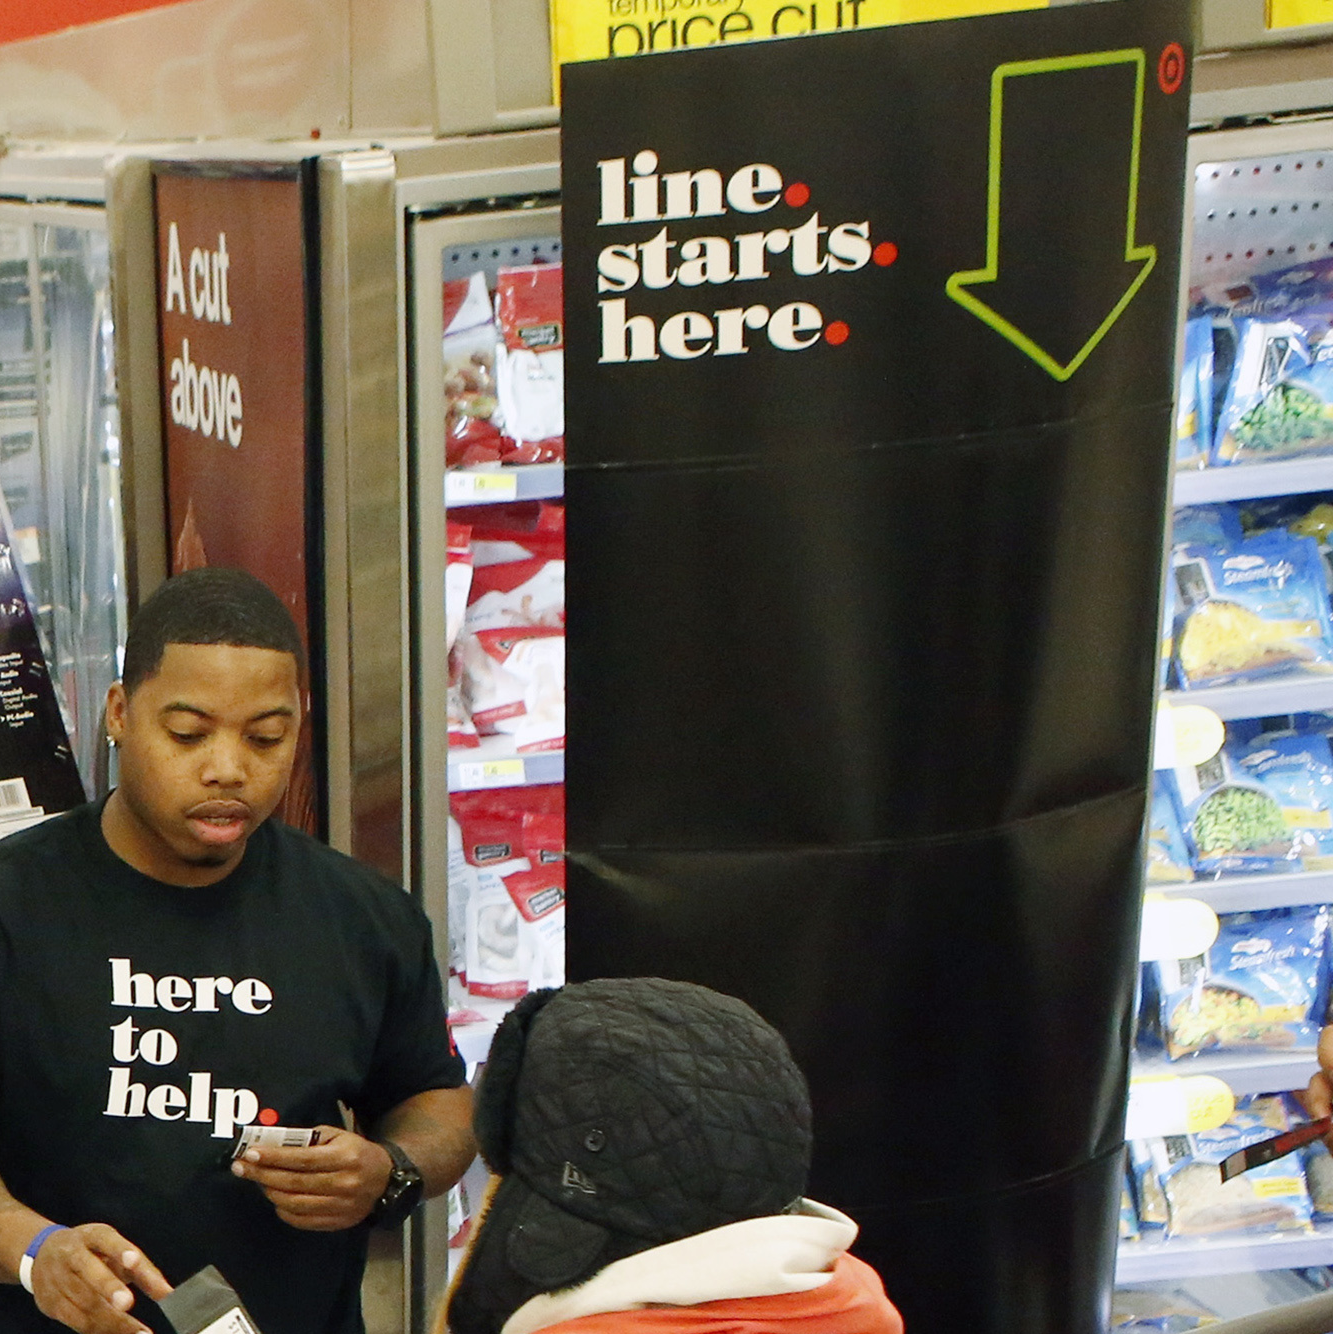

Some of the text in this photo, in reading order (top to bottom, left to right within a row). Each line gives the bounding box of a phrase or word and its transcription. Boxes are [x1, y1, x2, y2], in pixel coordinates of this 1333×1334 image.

[596, 149, 811, 227] line.
[165, 222, 231, 325] A cut
[596, 211, 898, 296] starts.
[596, 295, 850, 365] here.
[170, 338, 243, 448] above
[108, 957, 273, 1016] here
[110, 1015, 178, 1066] to
[102, 1067, 279, 1138] help.
